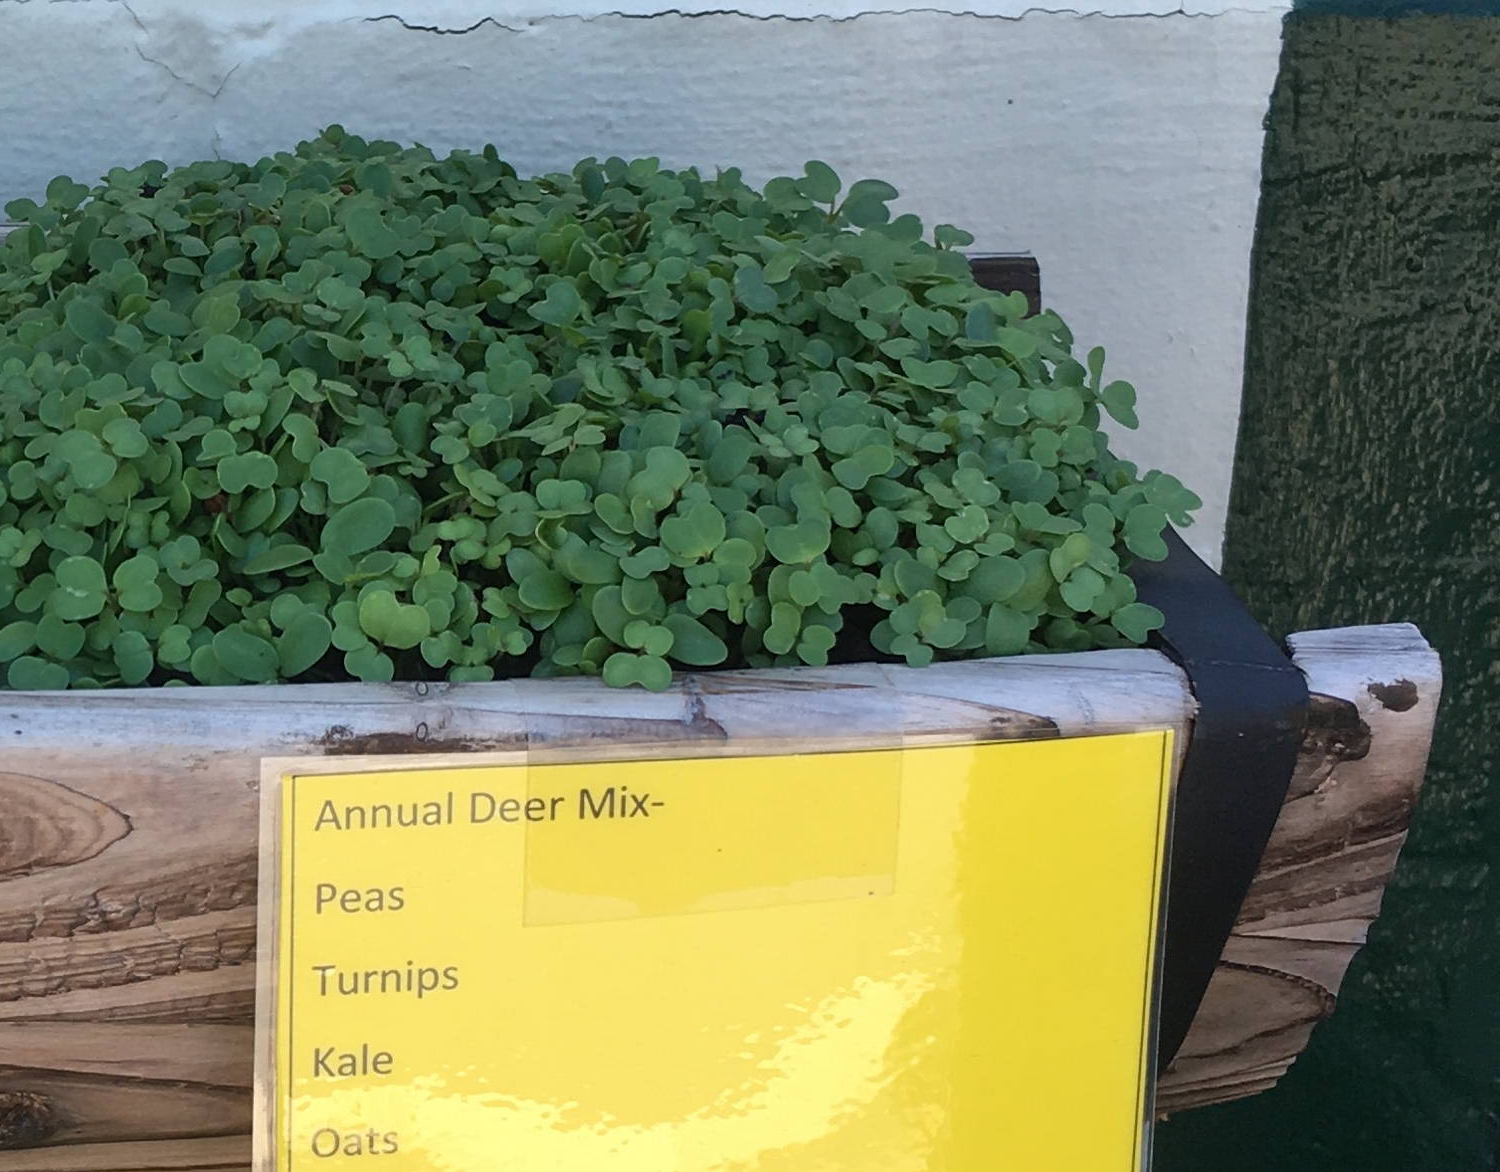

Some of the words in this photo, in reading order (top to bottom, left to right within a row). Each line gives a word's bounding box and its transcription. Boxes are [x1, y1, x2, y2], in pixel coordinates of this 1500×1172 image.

[314, 792, 454, 832] Annual
[469, 791, 564, 825] Deer
[577, 784, 666, 821] Mix-
[313, 880, 405, 916] Peas
[312, 958, 460, 999] Turnips
[311, 1043, 394, 1079] Kale
[310, 1125, 399, 1159] Oats
